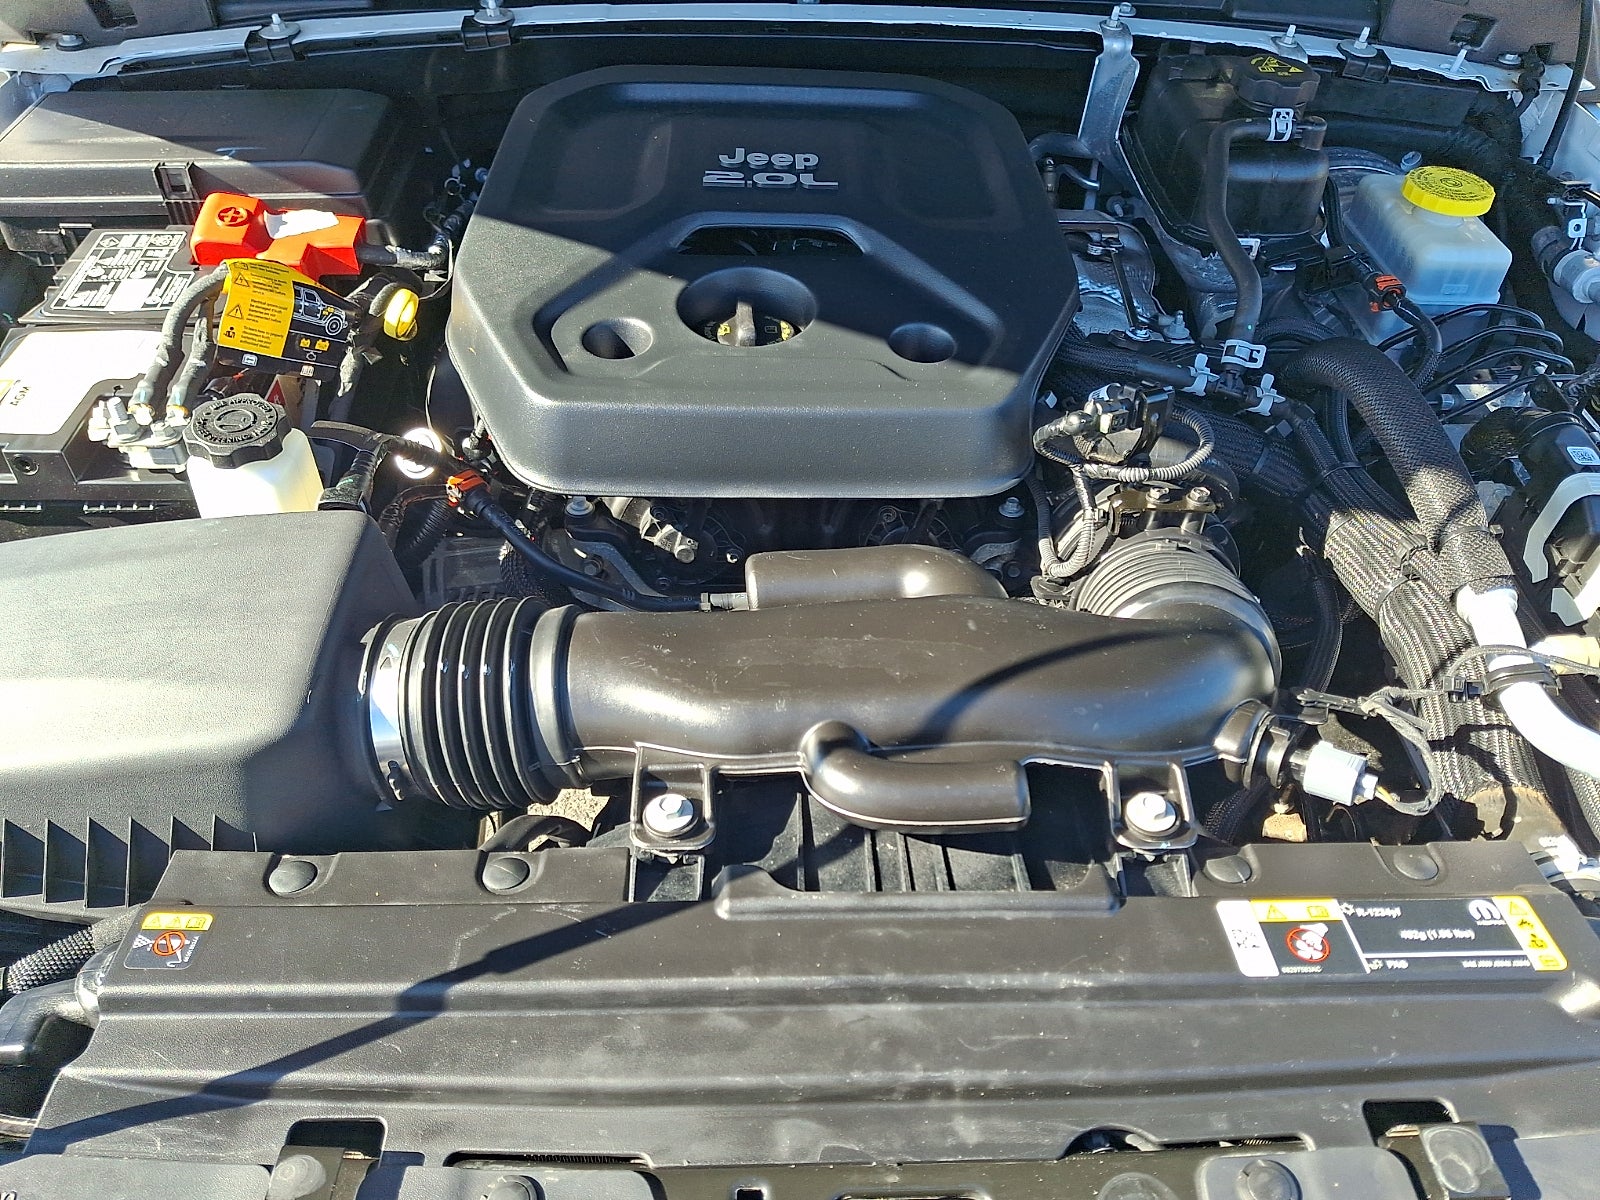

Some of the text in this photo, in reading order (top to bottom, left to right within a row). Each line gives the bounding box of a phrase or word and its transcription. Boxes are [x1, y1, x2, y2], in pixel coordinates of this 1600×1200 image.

[718, 147, 819, 170] Jeep
[702, 170, 838, 188] 2.0L
[229, 398, 272, 413] APPROVED
